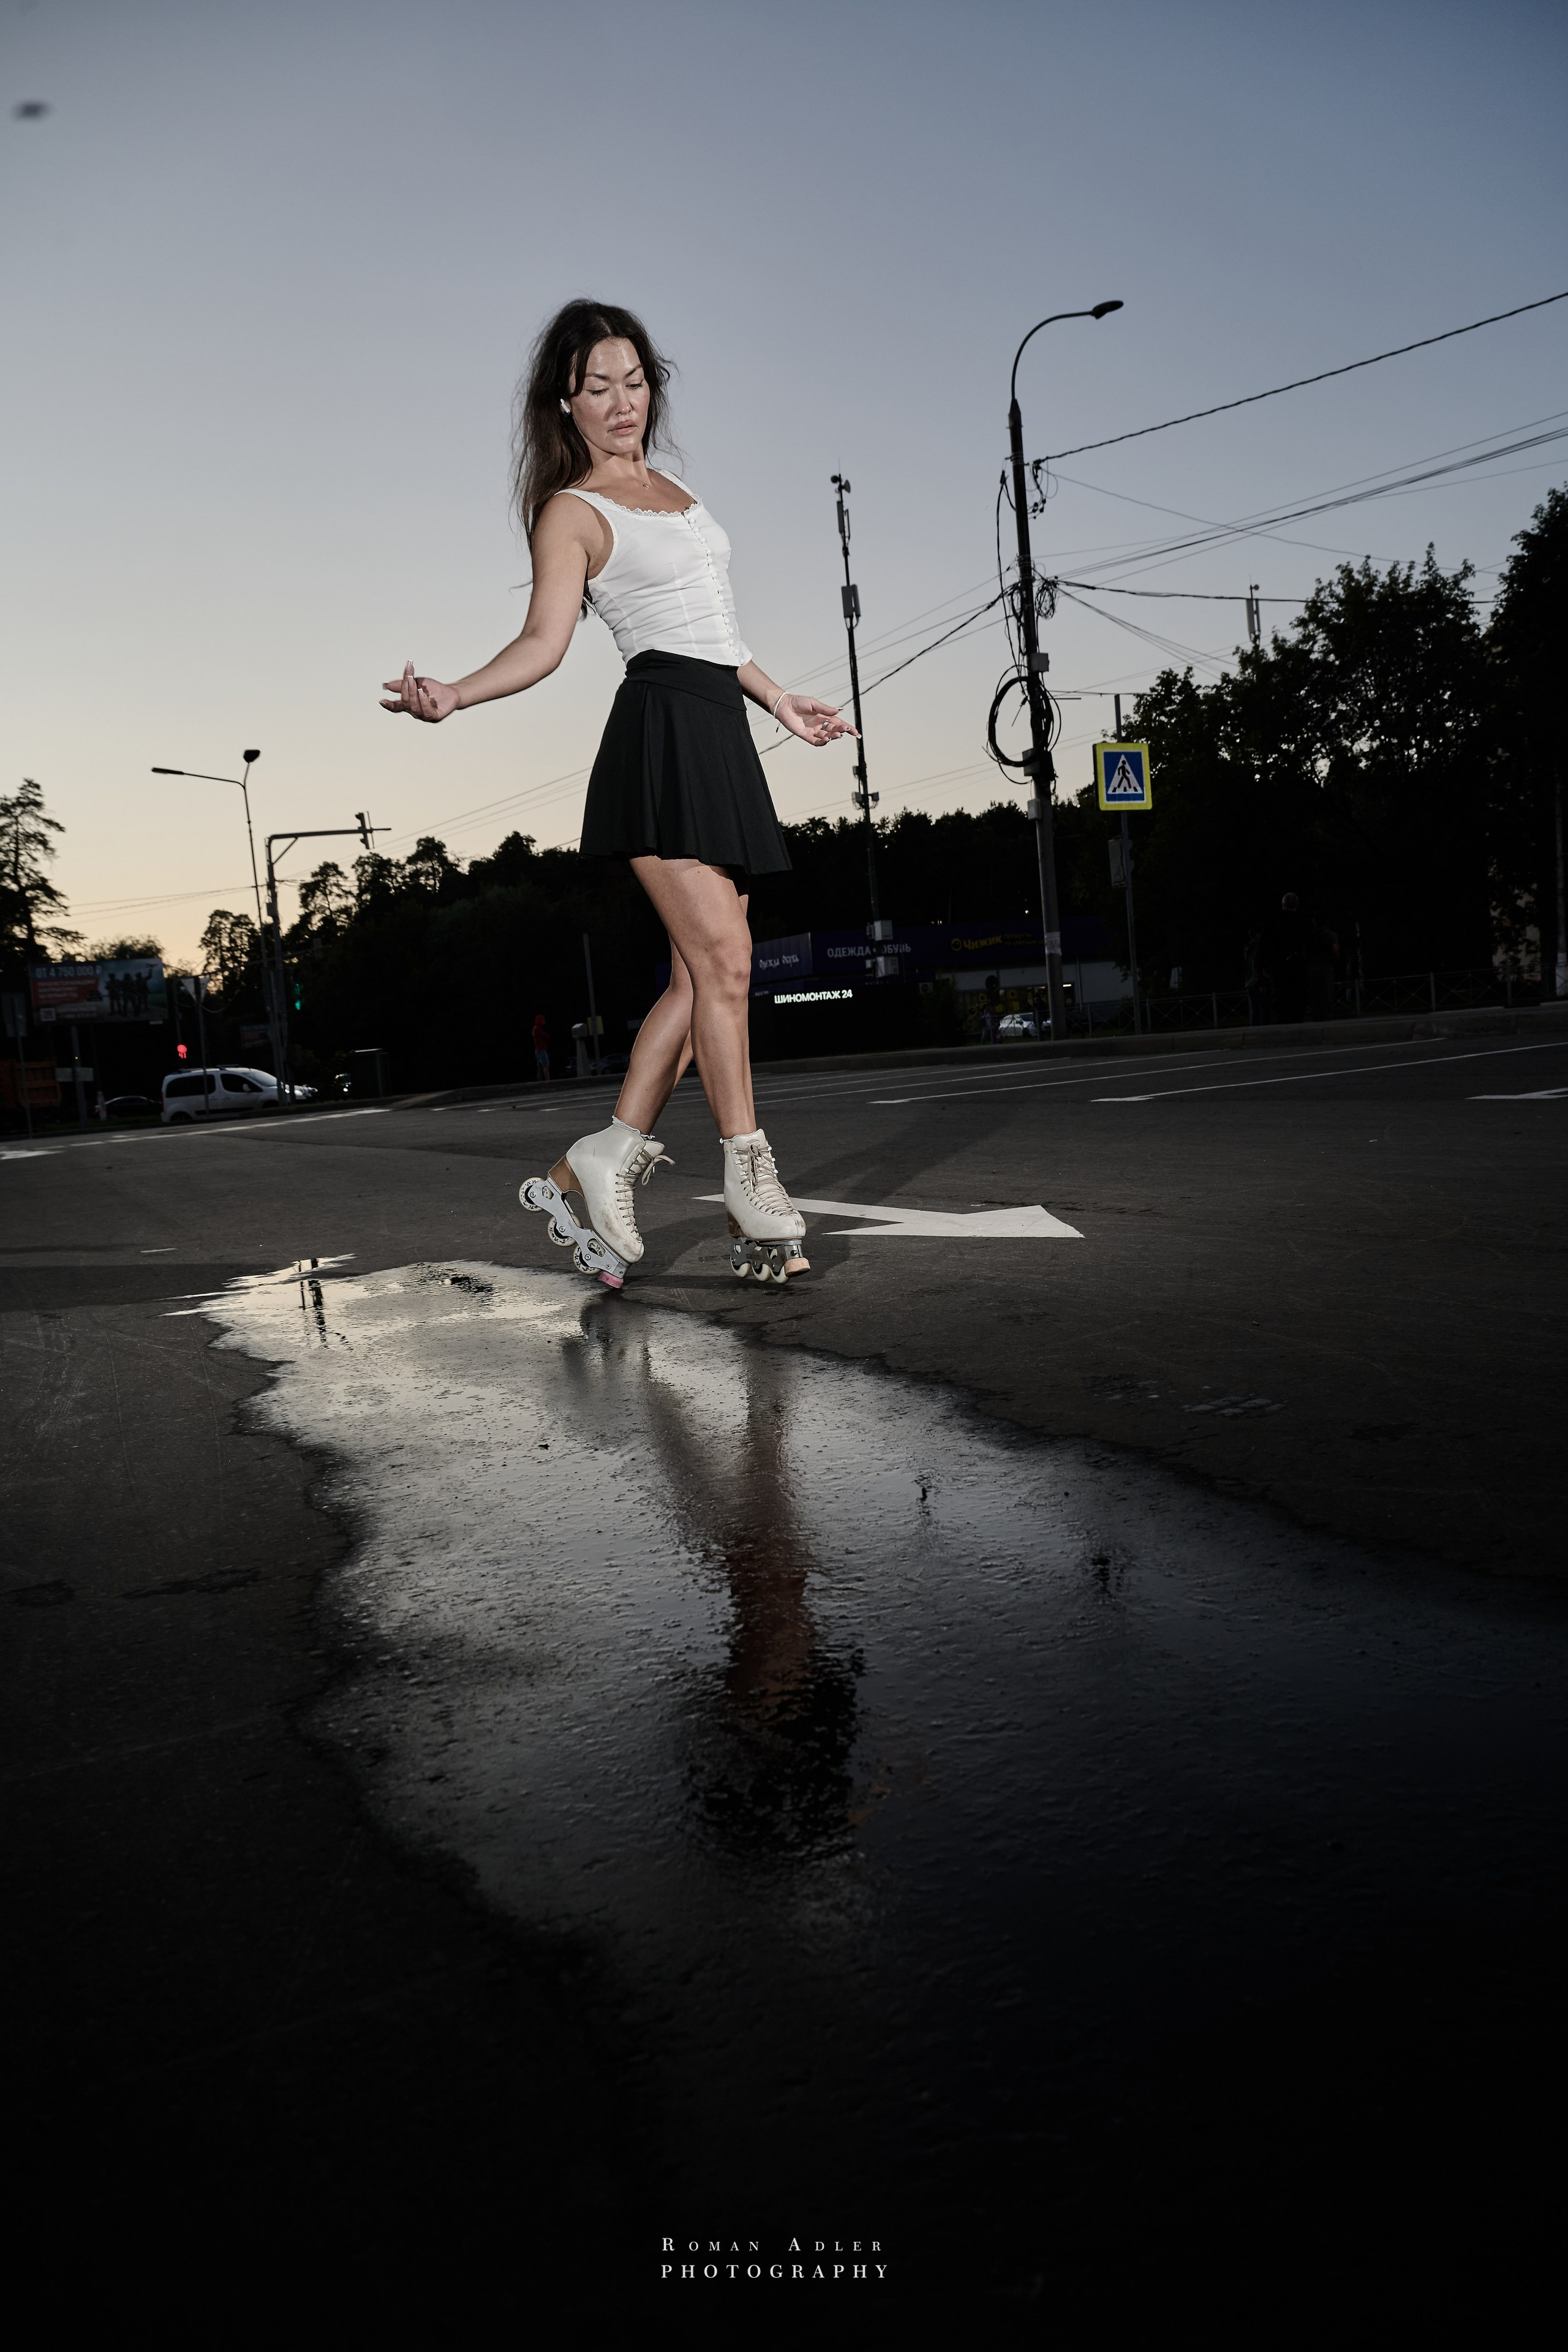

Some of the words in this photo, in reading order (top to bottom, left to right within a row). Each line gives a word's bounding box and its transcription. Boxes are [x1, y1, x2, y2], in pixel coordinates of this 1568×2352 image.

[827, 946, 872, 959] ОДЕЖДА
[774, 990, 841, 1005] ШИНОМОНТАЖ
[841, 989, 853, 999] 24
